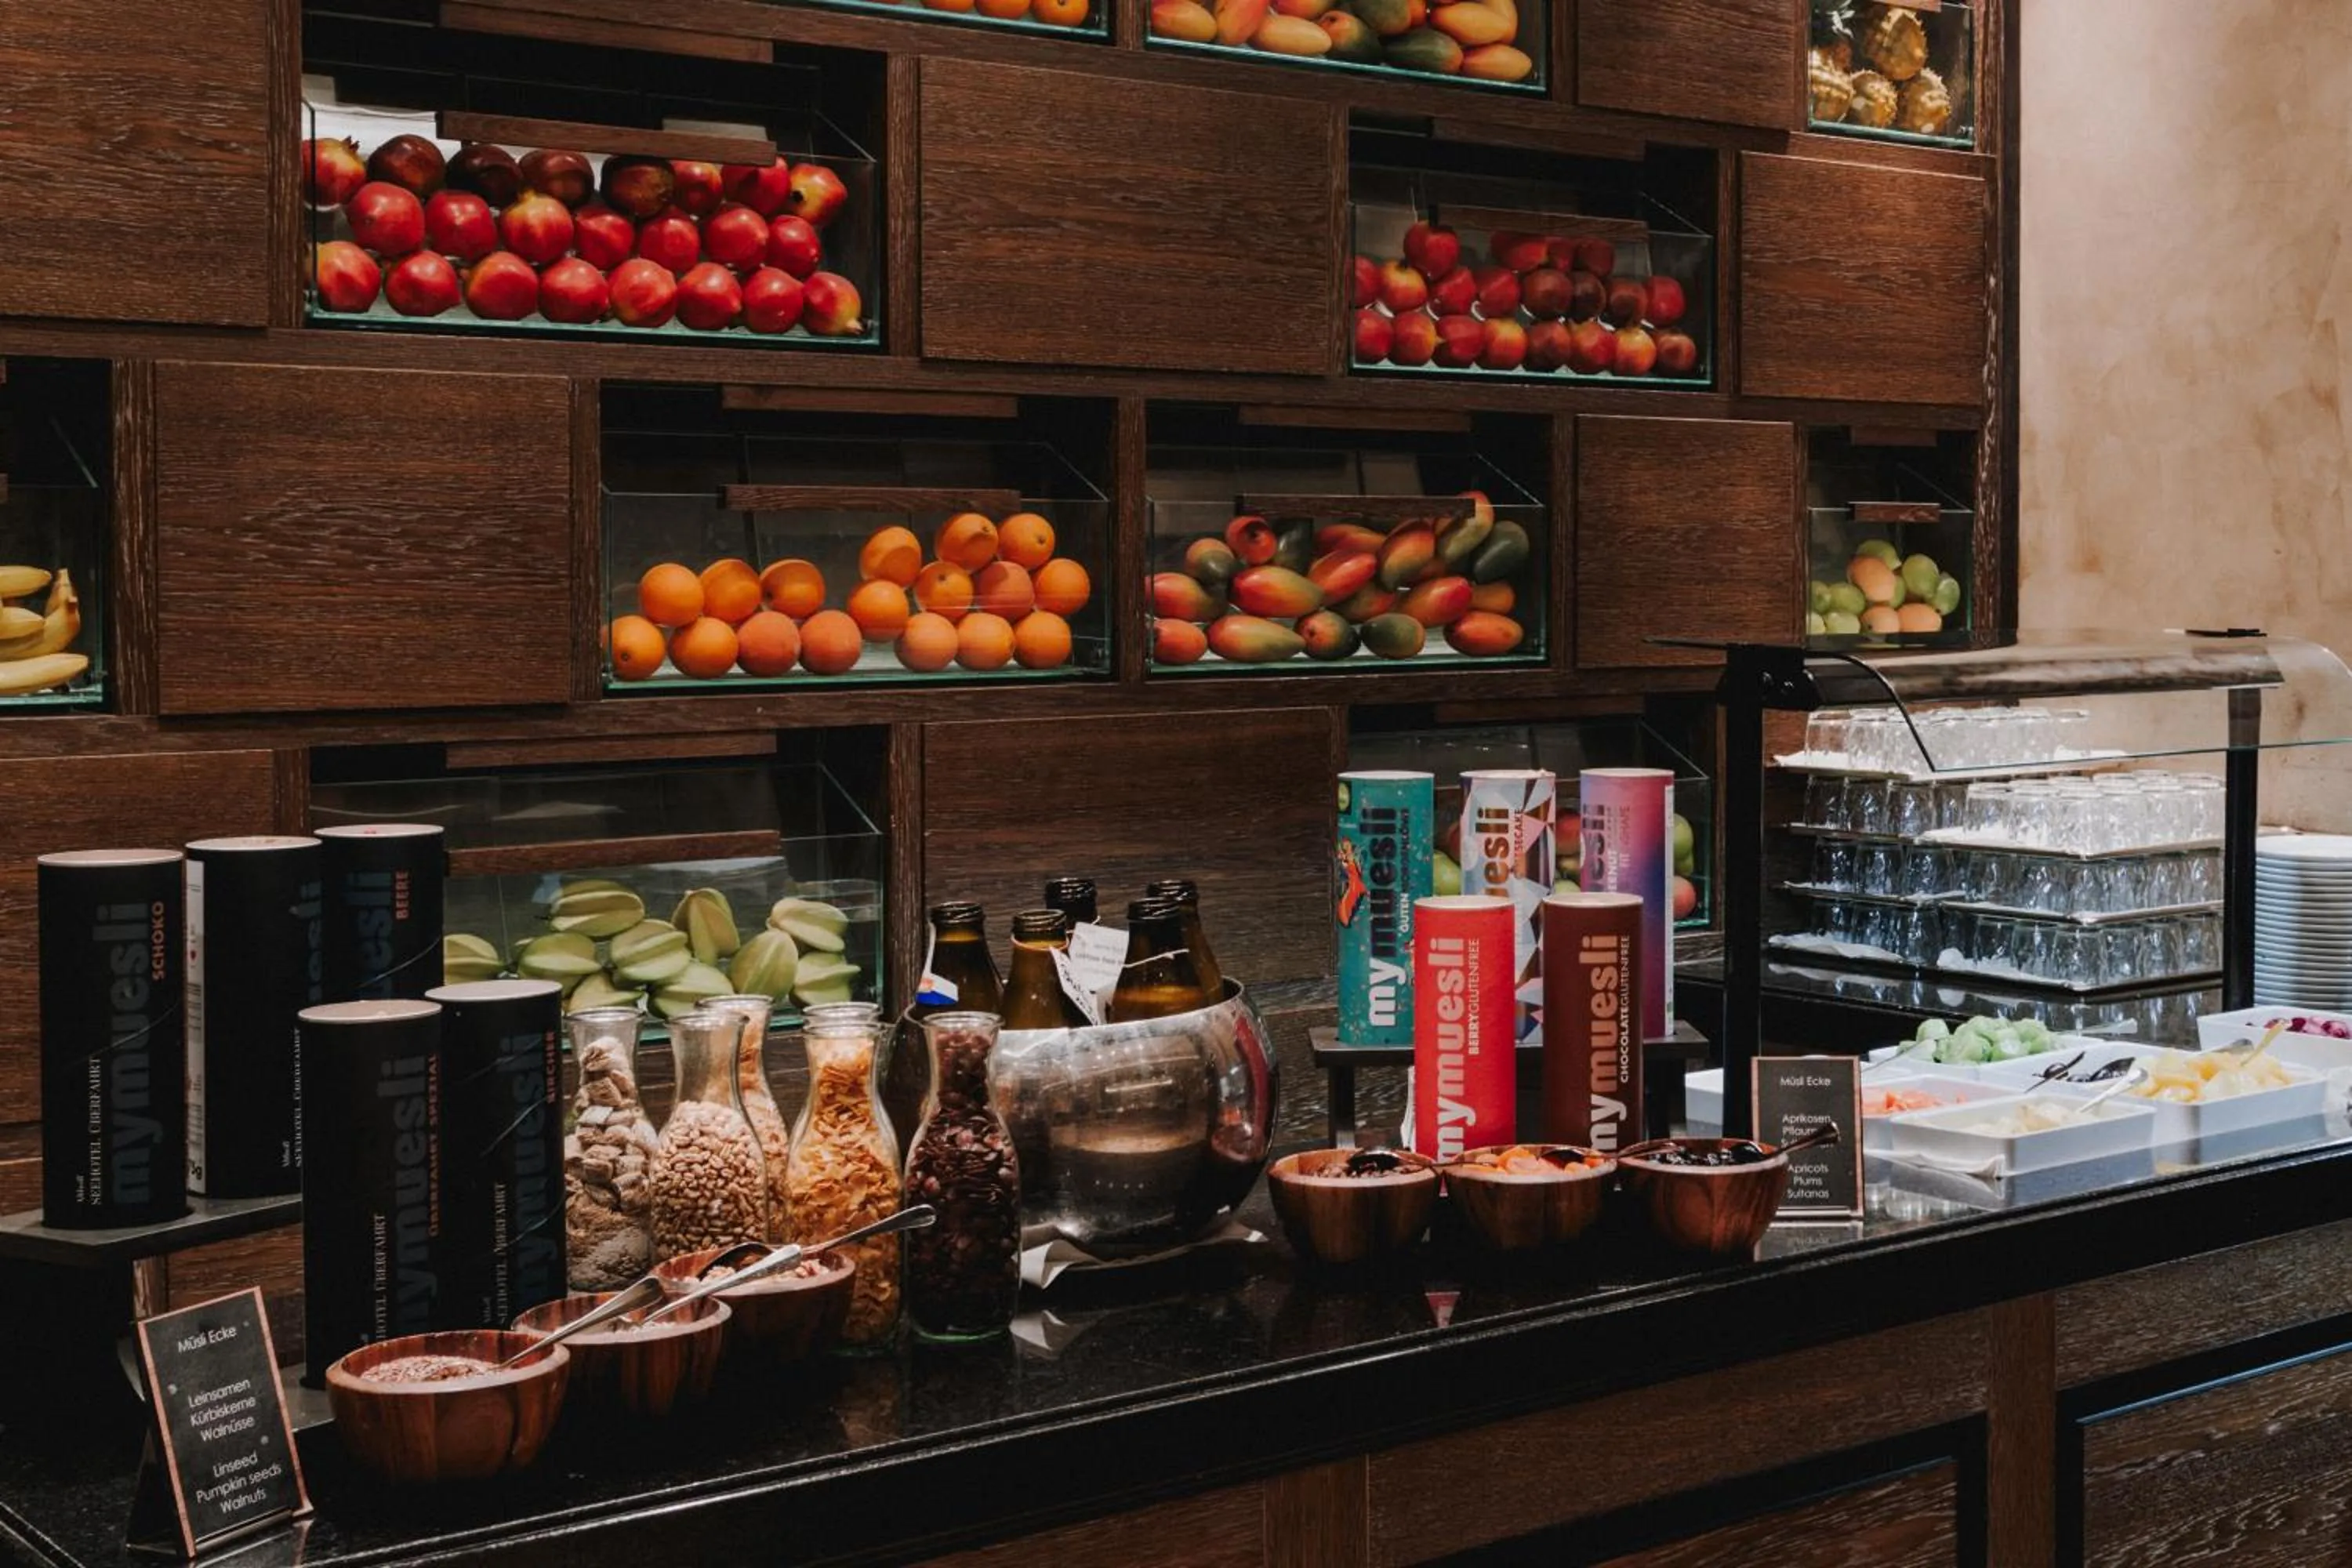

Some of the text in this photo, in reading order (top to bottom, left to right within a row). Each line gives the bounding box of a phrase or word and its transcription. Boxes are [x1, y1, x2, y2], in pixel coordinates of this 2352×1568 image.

[1475, 808, 1509, 897] esli
[394, 869, 410, 920] BEERE
[1360, 808, 1406, 1027] mymuesli
[151, 900, 165, 982] SCHOKO
[344, 871, 393, 999] uesli
[92, 902, 163, 1205] mymuesli
[1428, 938, 1476, 1163] mymuesli
[1579, 935, 1628, 1152] mymuesli
[1780, 1076, 1831, 1087] Müsli Ecke
[1781, 1114, 1831, 1124] Aprikosen
[1782, 1126, 1817, 1138] Pflaum
[89, 1138, 102, 1206] SEEHOTEL
[1788, 1163, 1829, 1174] Apricots
[1793, 1176, 1823, 1186] Plums
[1787, 1189, 1830, 1200] Sultanas
[374, 1295, 387, 1340] HOTEL
[177, 1325, 238, 1354] Müsli Ecke
[187, 1378, 251, 1409] Leinsamen
[190, 1396, 256, 1428] Kürbiskerne
[200, 1417, 254, 1443] Walnüsse
[212, 1451, 258, 1479] Linseed
[197, 1465, 282, 1504] Pumpkin seeds
[220, 1487, 267, 1514] Walnuts
